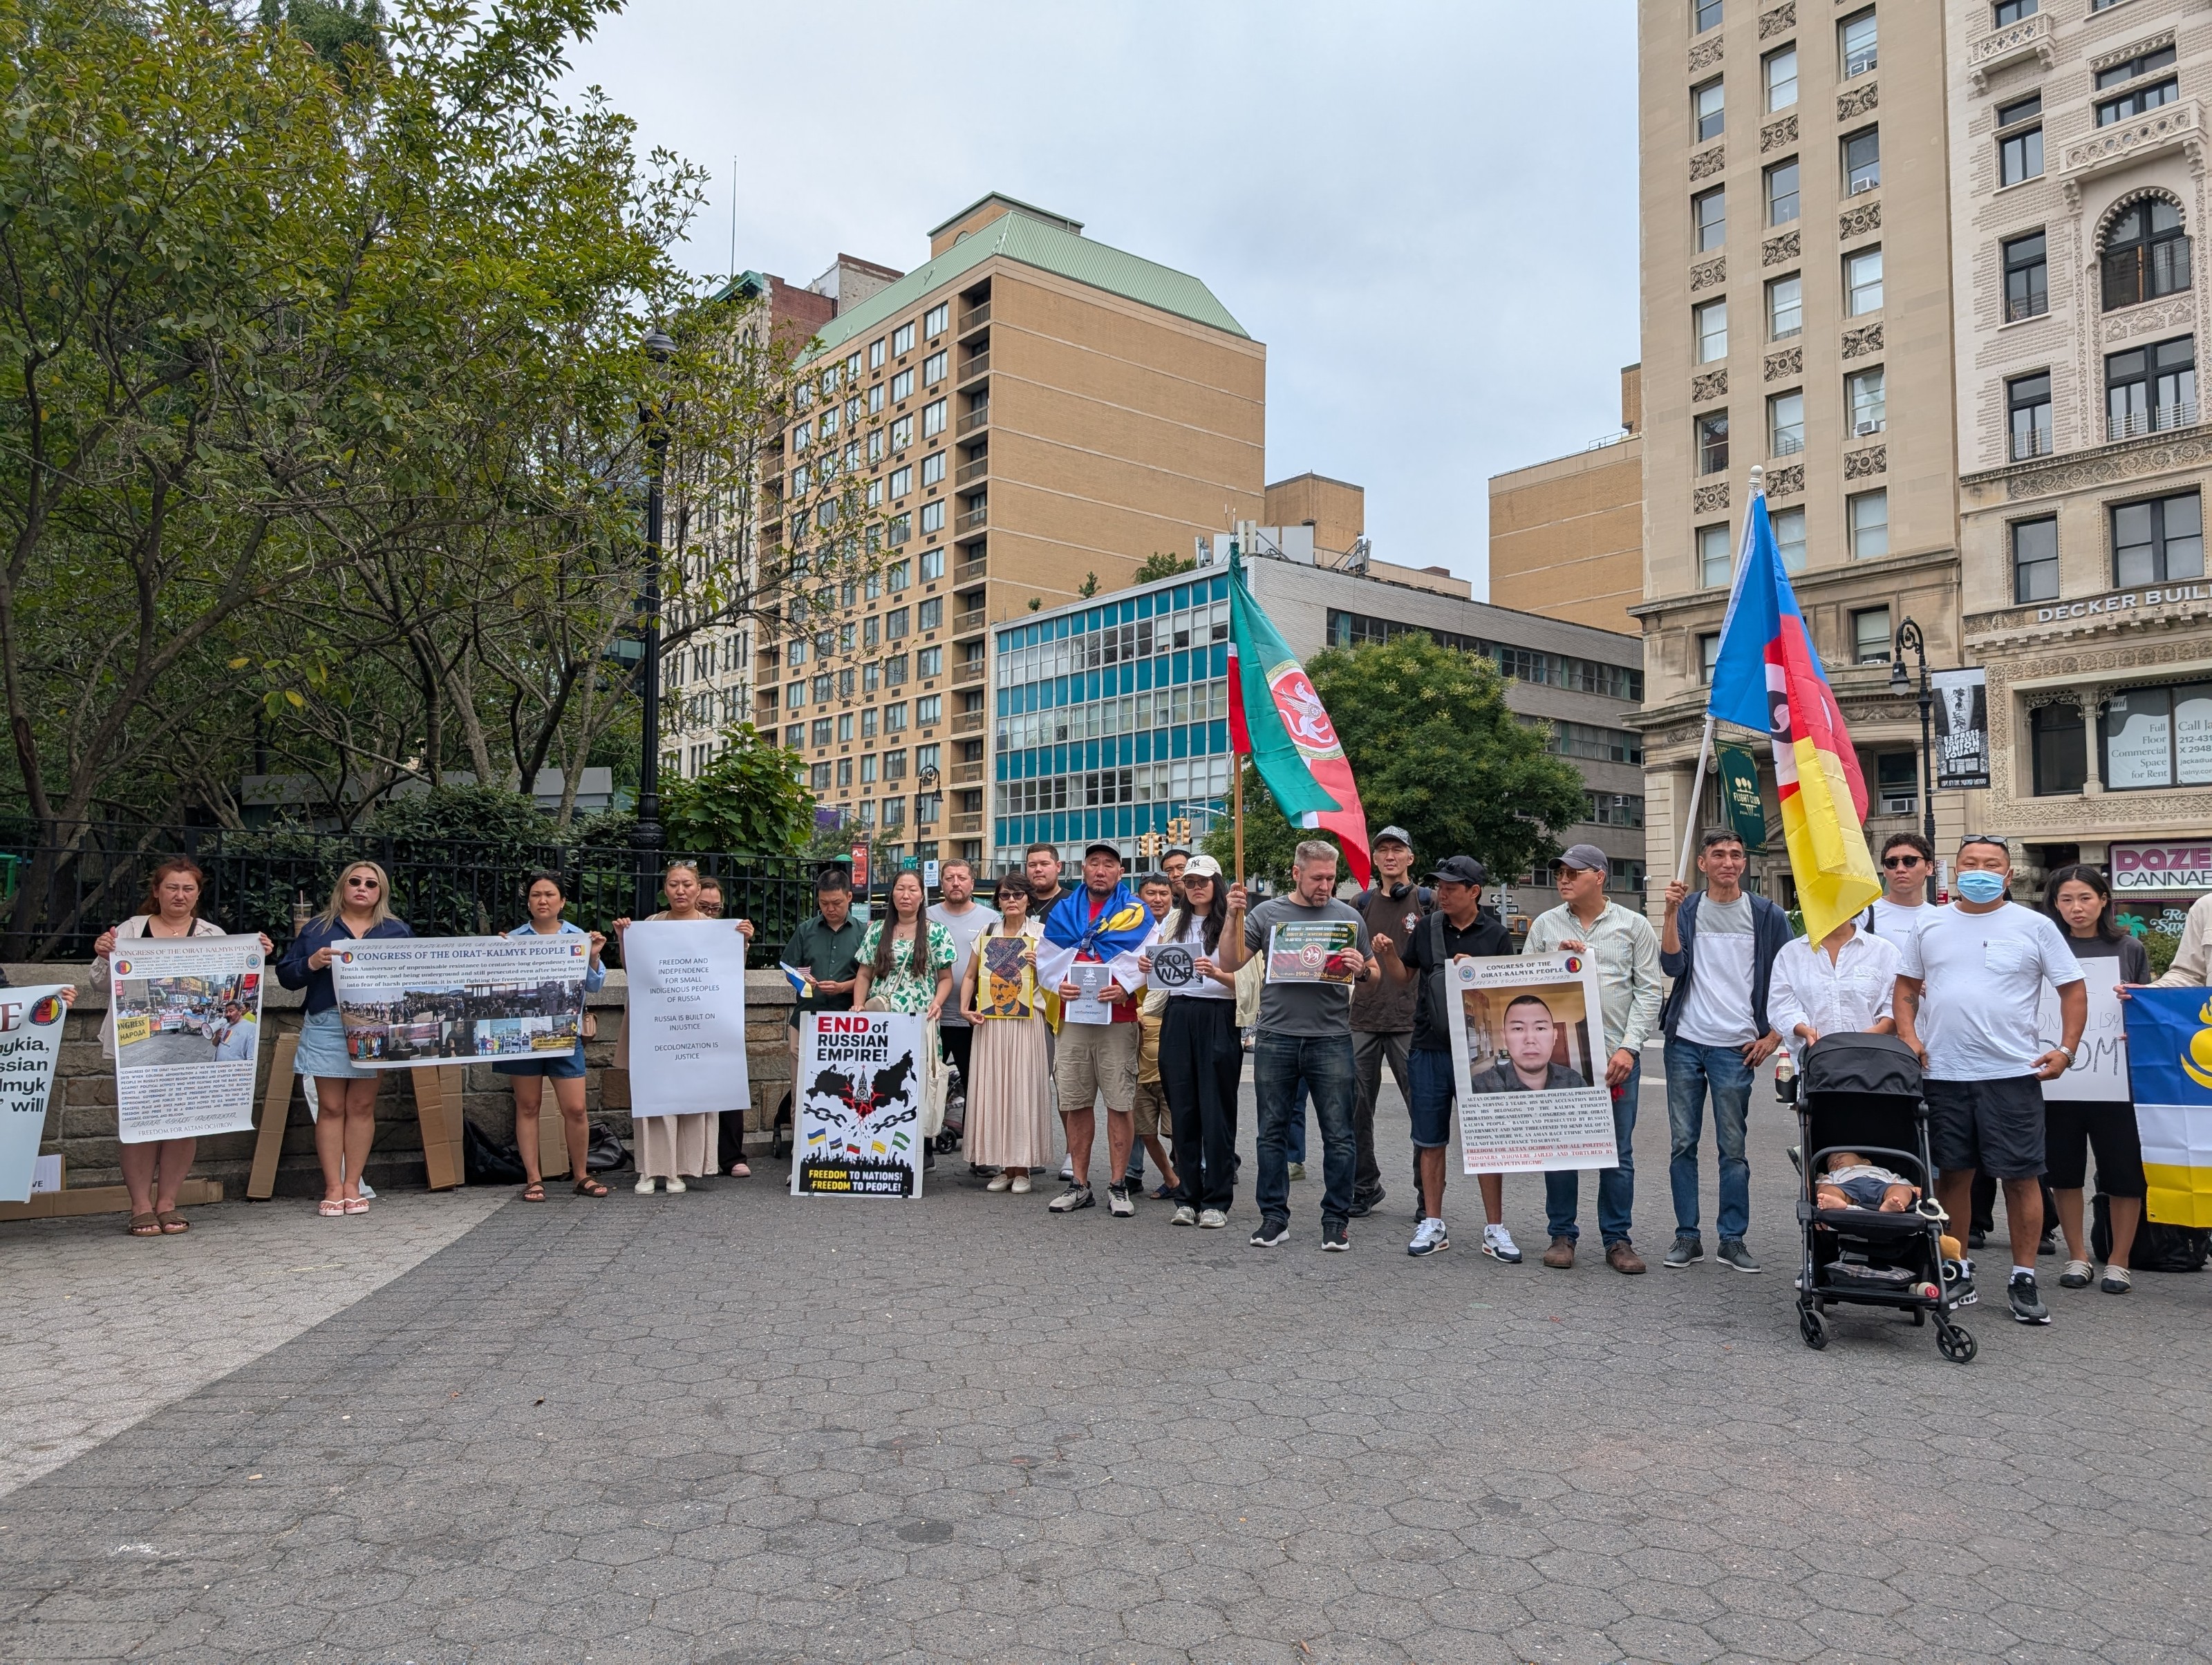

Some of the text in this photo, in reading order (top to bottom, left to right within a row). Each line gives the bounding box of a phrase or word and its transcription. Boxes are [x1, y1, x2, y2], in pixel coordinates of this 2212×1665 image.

[2038, 584, 2212, 623] DECKER BUIL
[2150, 723, 2166, 732] Full
[2178, 720, 2200, 731] Call
[1943, 728, 1980, 743] EXPRESS
[1944, 734, 1980, 747] YOURSELF
[2143, 736, 2166, 744] Floor
[1944, 740, 1980, 754] UNION
[2112, 746, 2166, 758] Commercial
[1944, 747, 1980, 760] SQUARE
[2140, 759, 2167, 769] Space
[1733, 791, 1761, 805] FLIGHT CLUB
[357, 946, 566, 961] CONGRESS OF THE OIRAT-KALMYK PEOPLE
[1158, 954, 1190, 966] STOP
[487, 968, 519, 977] persecuted
[658, 967, 709, 975] INDEPENDENCE
[1157, 967, 1194, 980] WAR
[1481, 969, 1534, 978] OIRAT-KALMYK
[818, 1017, 888, 1033] END of
[120, 1029, 146, 1041] НАРОДА
[818, 1034, 888, 1048] RUSSIAN
[655, 1042, 711, 1051] DECOLONIZATION
[817, 1048, 888, 1062] EMPIRE!
[11, 1097, 44, 1112] will
[204, 1122, 233, 1130] OCHIROV
[809, 1169, 903, 1181] FREEDOM TO NATIONS!
[812, 1180, 901, 1192] FREEDOM TO PEOPLE!
